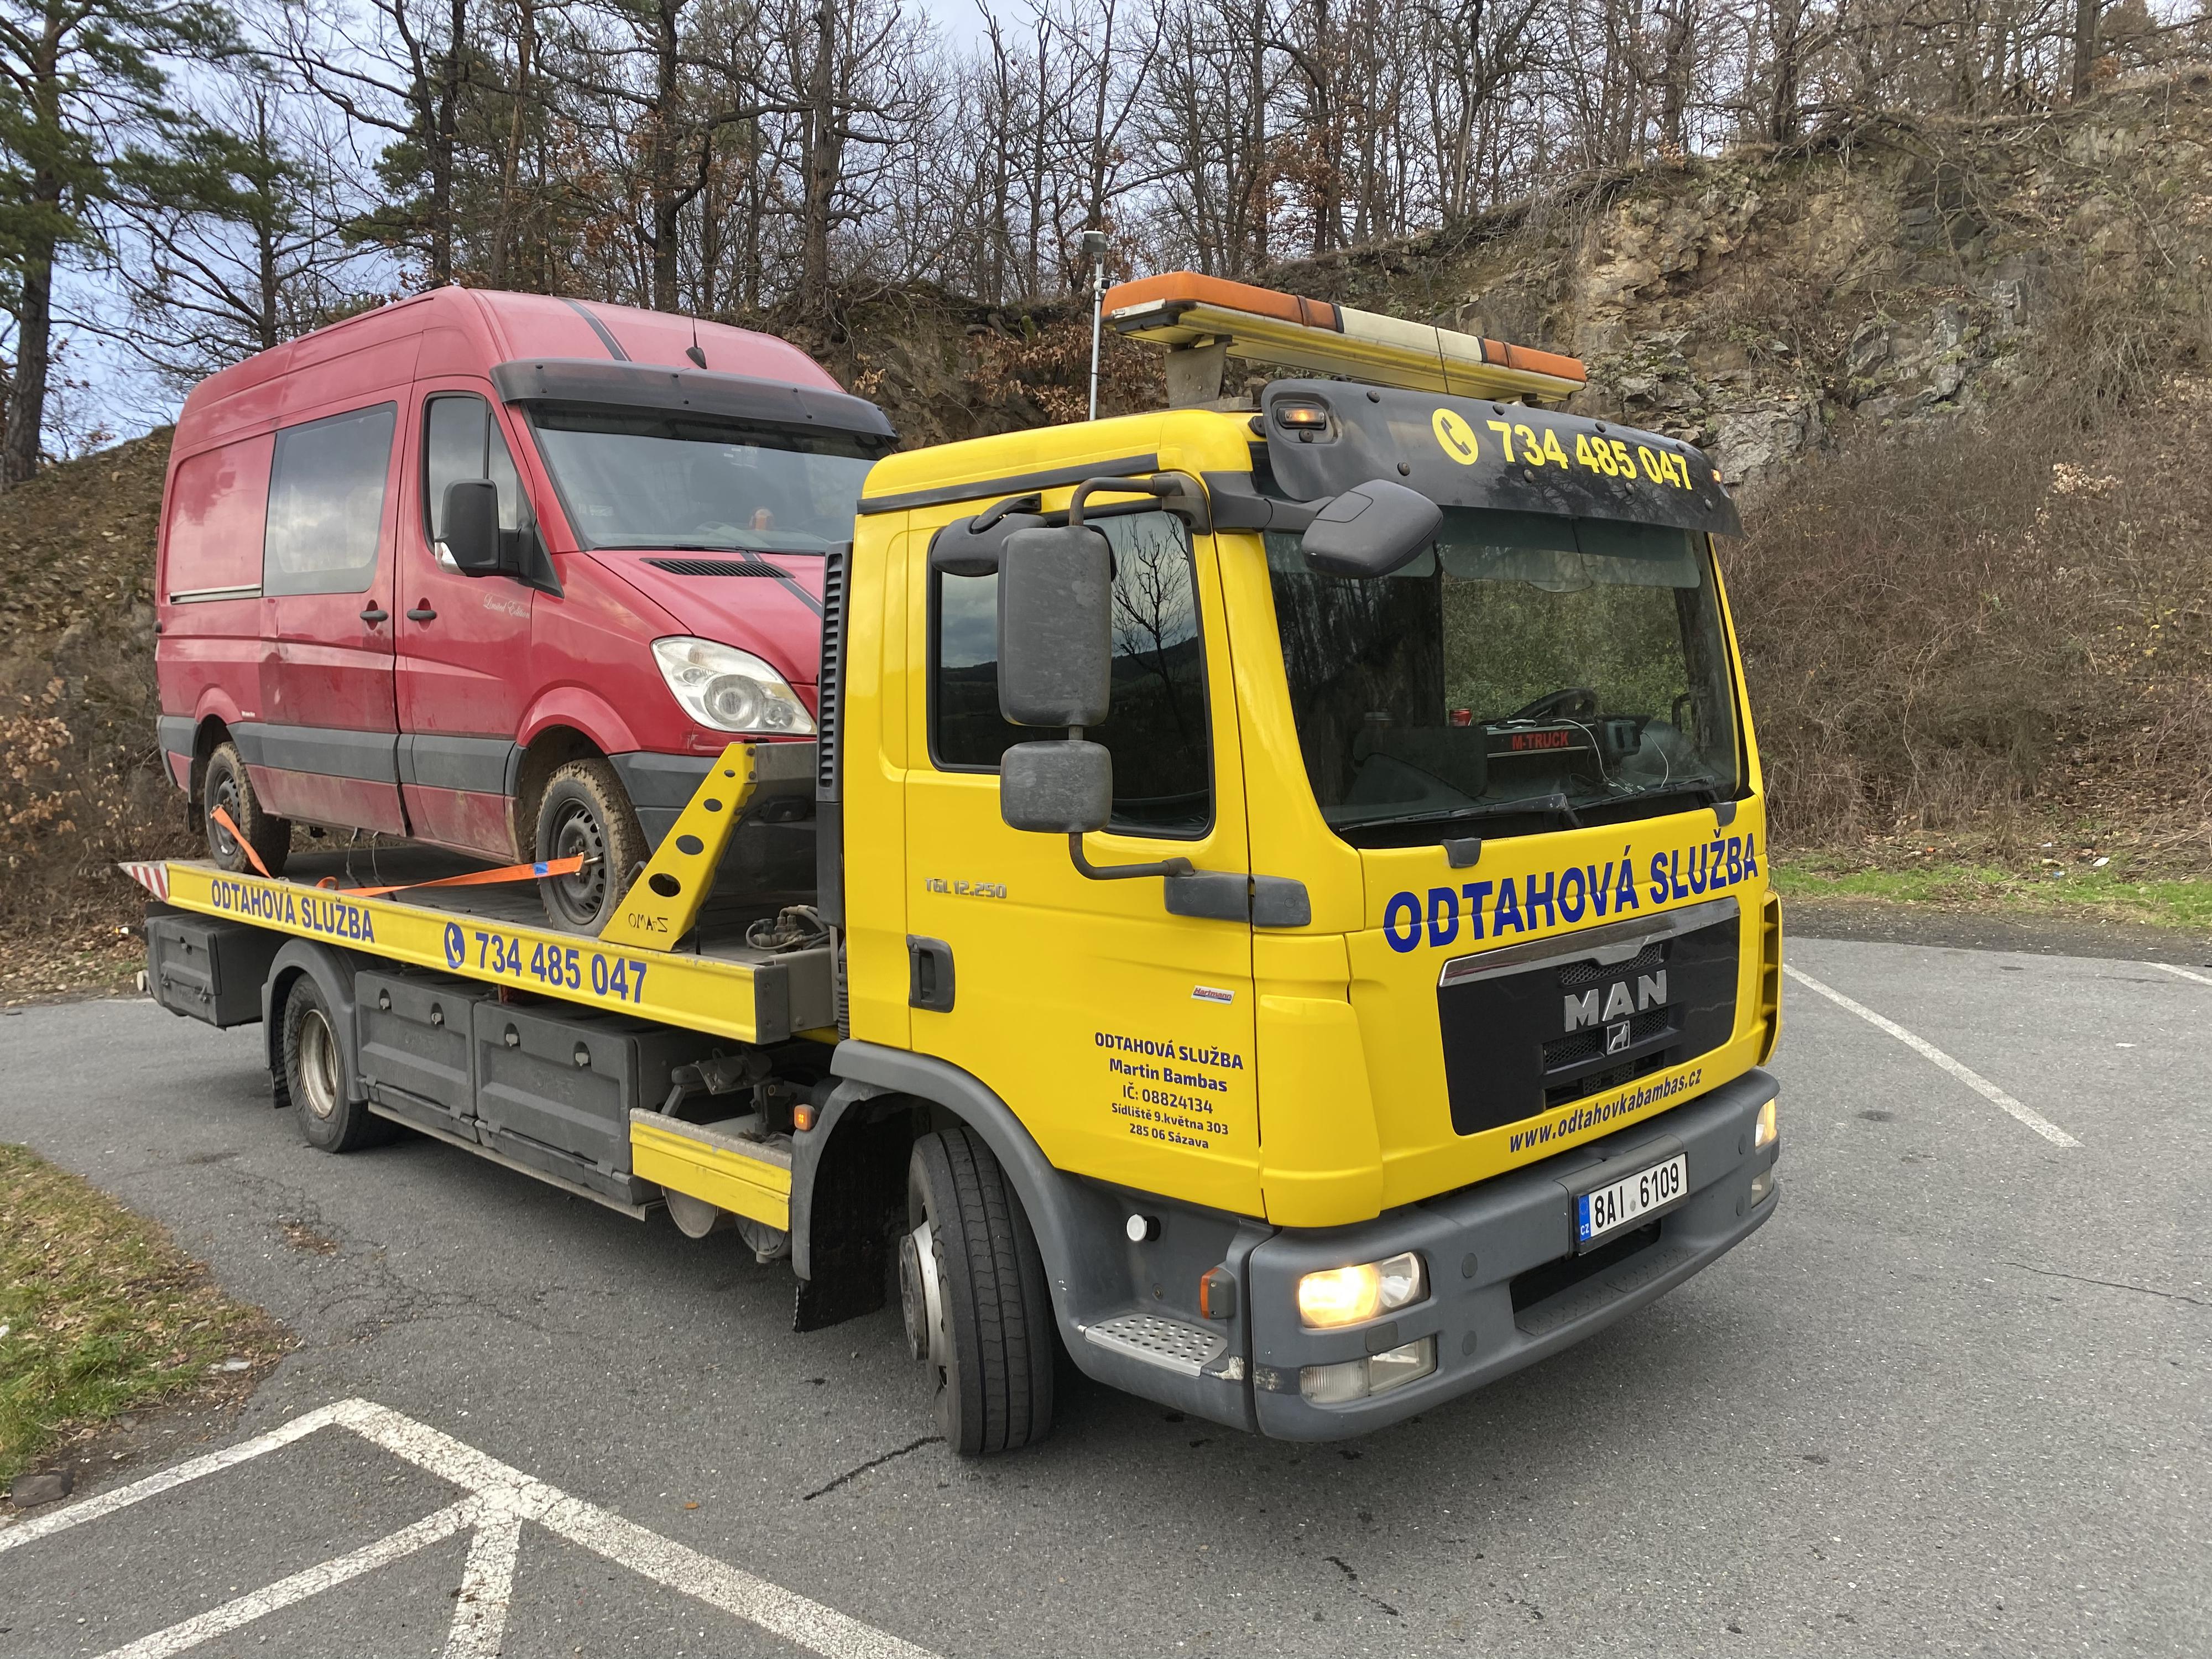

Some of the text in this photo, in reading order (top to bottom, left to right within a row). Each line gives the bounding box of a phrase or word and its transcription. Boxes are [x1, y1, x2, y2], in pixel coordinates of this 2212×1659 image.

[1486, 420, 1693, 490] 734 485 047
[483, 594, 530, 619] Limited Edition
[1512, 733, 1568, 749] M-TRUCK
[925, 878, 1007, 899] TGL 12.250
[1383, 829, 1759, 953] ODTAHOVÁ SLUŽBA
[212, 879, 374, 942] ODTAHOVÁ SLUŽBA
[475, 932, 647, 1003] 734 485 047
[1193, 988, 1232, 1000] Hartmann
[1564, 970, 1667, 1032] MAN
[1095, 1032, 1243, 1070] ODTAHOVÁ SLUŽBA
[1110, 1058, 1228, 1093] Martin Bambas
[1123, 1081, 1213, 1114] IČ: 08824134
[1510, 1068, 1702, 1153] www.odtahovkabambas.cz
[1112, 1103, 1229, 1135] Sídliště 9.května 303
[1129, 1124, 1209, 1149] 285 06 Sázava
[1594, 1162, 1679, 1228] 8AI 6109
[1580, 1223, 1590, 1236] CZ
